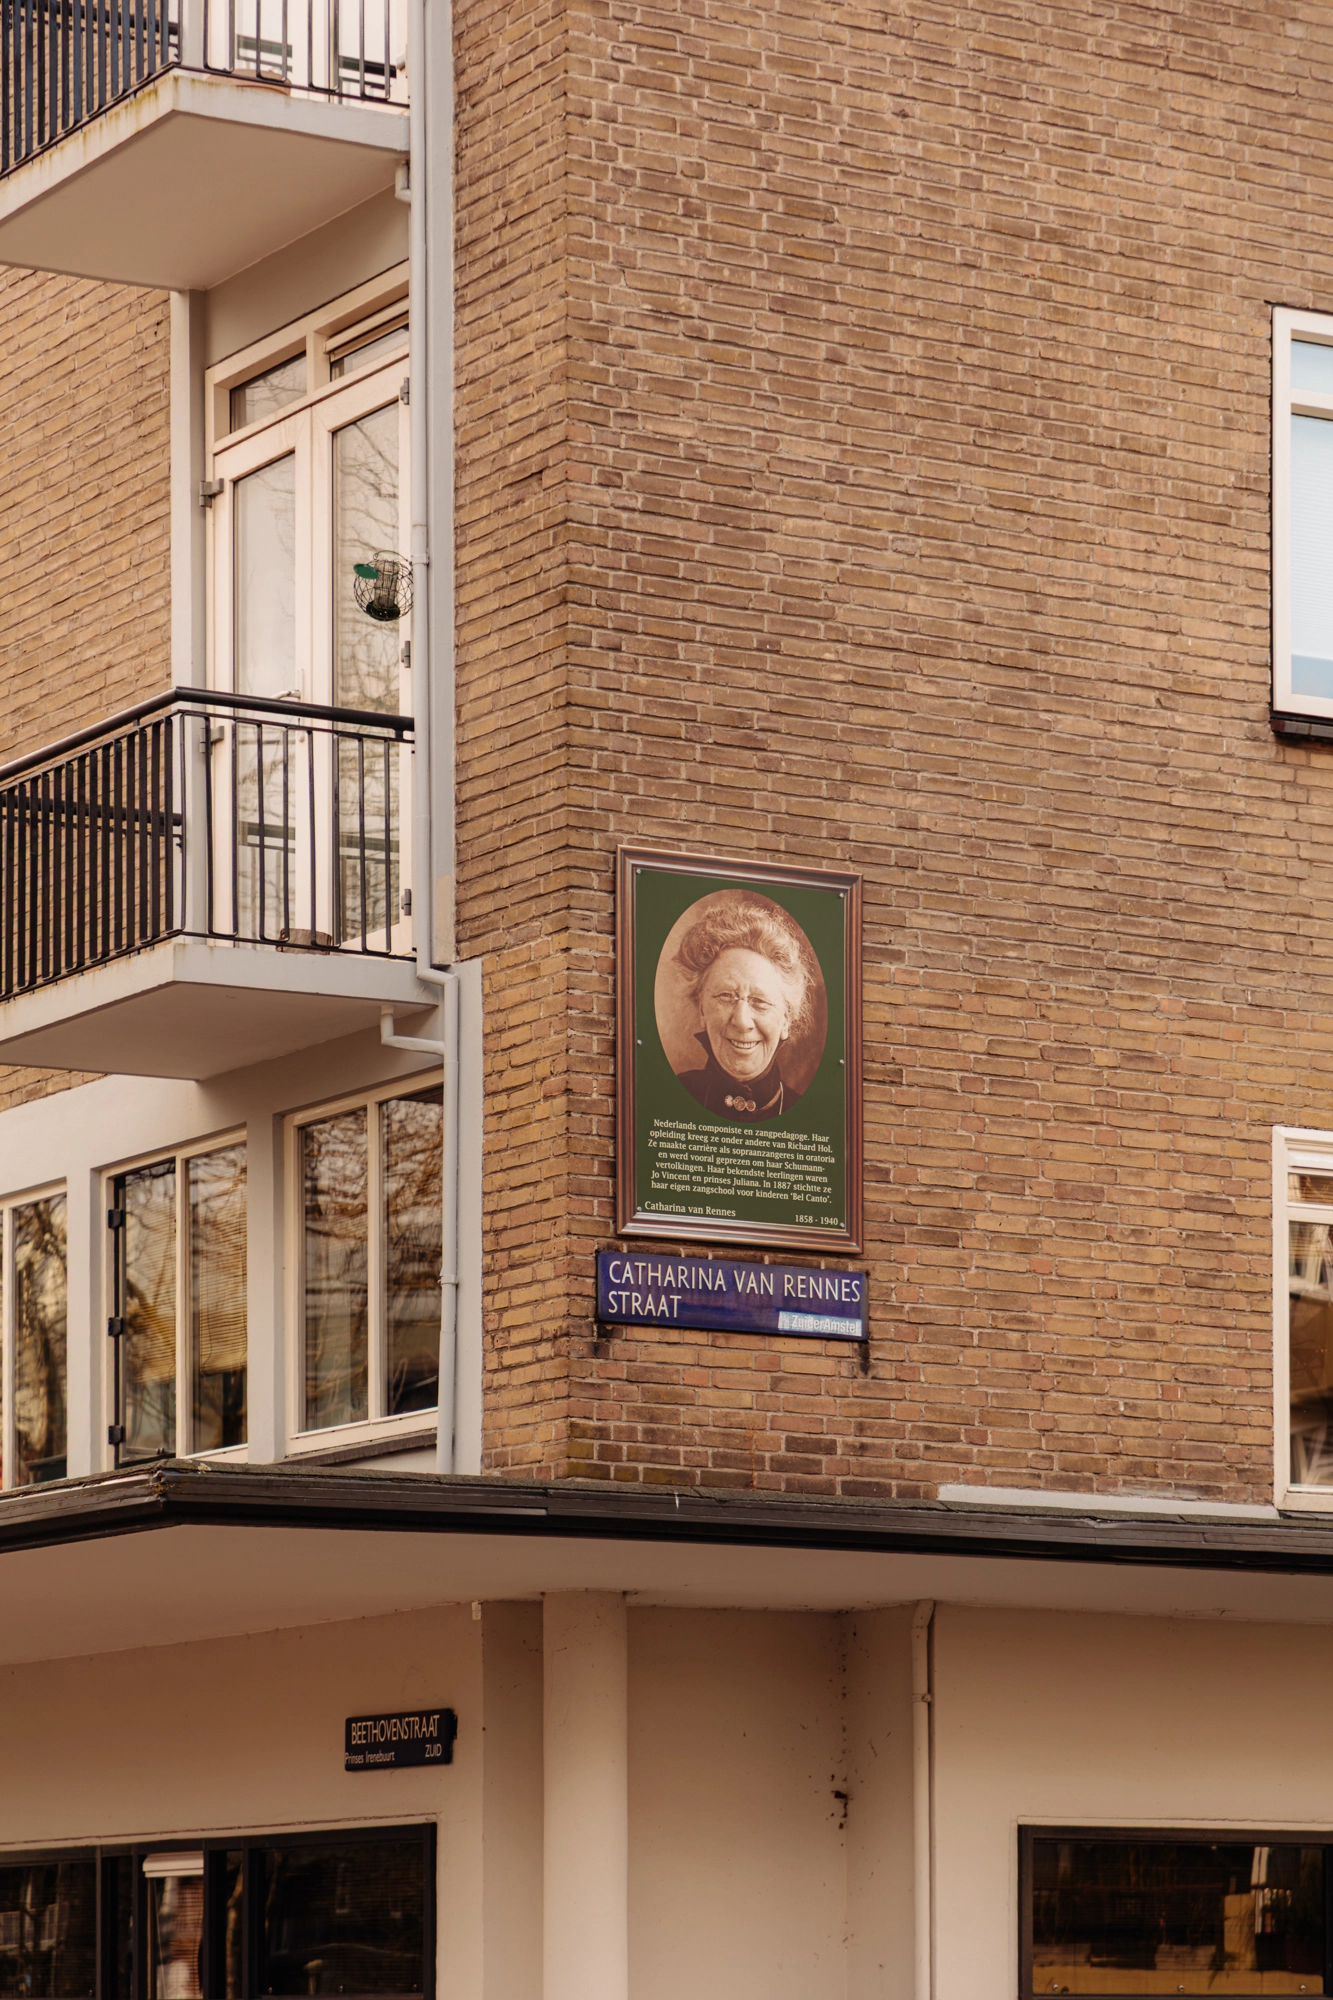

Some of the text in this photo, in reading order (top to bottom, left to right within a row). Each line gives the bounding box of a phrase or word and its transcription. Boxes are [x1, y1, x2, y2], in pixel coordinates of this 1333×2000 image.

[654, 1119, 696, 1130] Nederlands
[699, 1125, 742, 1134] componiste
[755, 1130, 809, 1141] zangpedagoge.
[812, 1134, 829, 1142] Haar
[648, 1139, 657, 1147] Ze
[659, 1141, 686, 1149] maakte
[689, 1144, 717, 1152] carrière
[719, 1146, 730, 1154] als
[732, 1148, 794, 1159] sopraanzangeres
[806, 1155, 835, 1163] oratoria
[650, 1130, 686, 1141] opleiding
[688, 1132, 708, 1143] kreeg
[721, 1136, 743, 1144] onder
[745, 1139, 770, 1147] andere
[788, 1142, 815, 1151] Richard
[818, 1145, 833, 1153] Hol.
[656, 1162, 705, 1172] vertolkingen.
[707, 1165, 725, 1173] Haar
[727, 1167, 764, 1177] bekendste
[767, 1170, 803, 1181] leerlingen
[670, 1152, 688, 1160] werd
[716, 1157, 750, 1165] geprezen
[766, 1160, 782, 1168] haar
[784, 1162, 825, 1172] Schumann-
[651, 1170, 659, 1179] Jo
[662, 1171, 690, 1180] Vincent
[704, 1176, 731, 1184] prinses
[733, 1178, 761, 1187] Juliana.
[763, 1180, 770, 1188] In
[773, 1181, 791, 1189] 1887
[793, 1183, 821, 1192] stichtte
[651, 1180, 668, 1189] haar
[670, 1183, 690, 1192] eigen
[693, 1185, 734, 1195] zangschool
[756, 1189, 788, 1199] kinderen
[645, 1201, 686, 1213] Catharina
[706, 1206, 736, 1217] Rennes
[795, 1215, 813, 1223] 1858
[820, 1217, 838, 1225] 1940
[609, 1260, 861, 1303] CATHARINA VAN RENNES
[608, 1291, 682, 1318] STRAAT
[791, 1315, 858, 1333] ZuiderAmstel
[351, 1715, 440, 1744] BEETHOVENSTRAAT
[345, 1750, 395, 1764] Prinses Irenebuurt
[425, 1744, 442, 1757] ZUID
